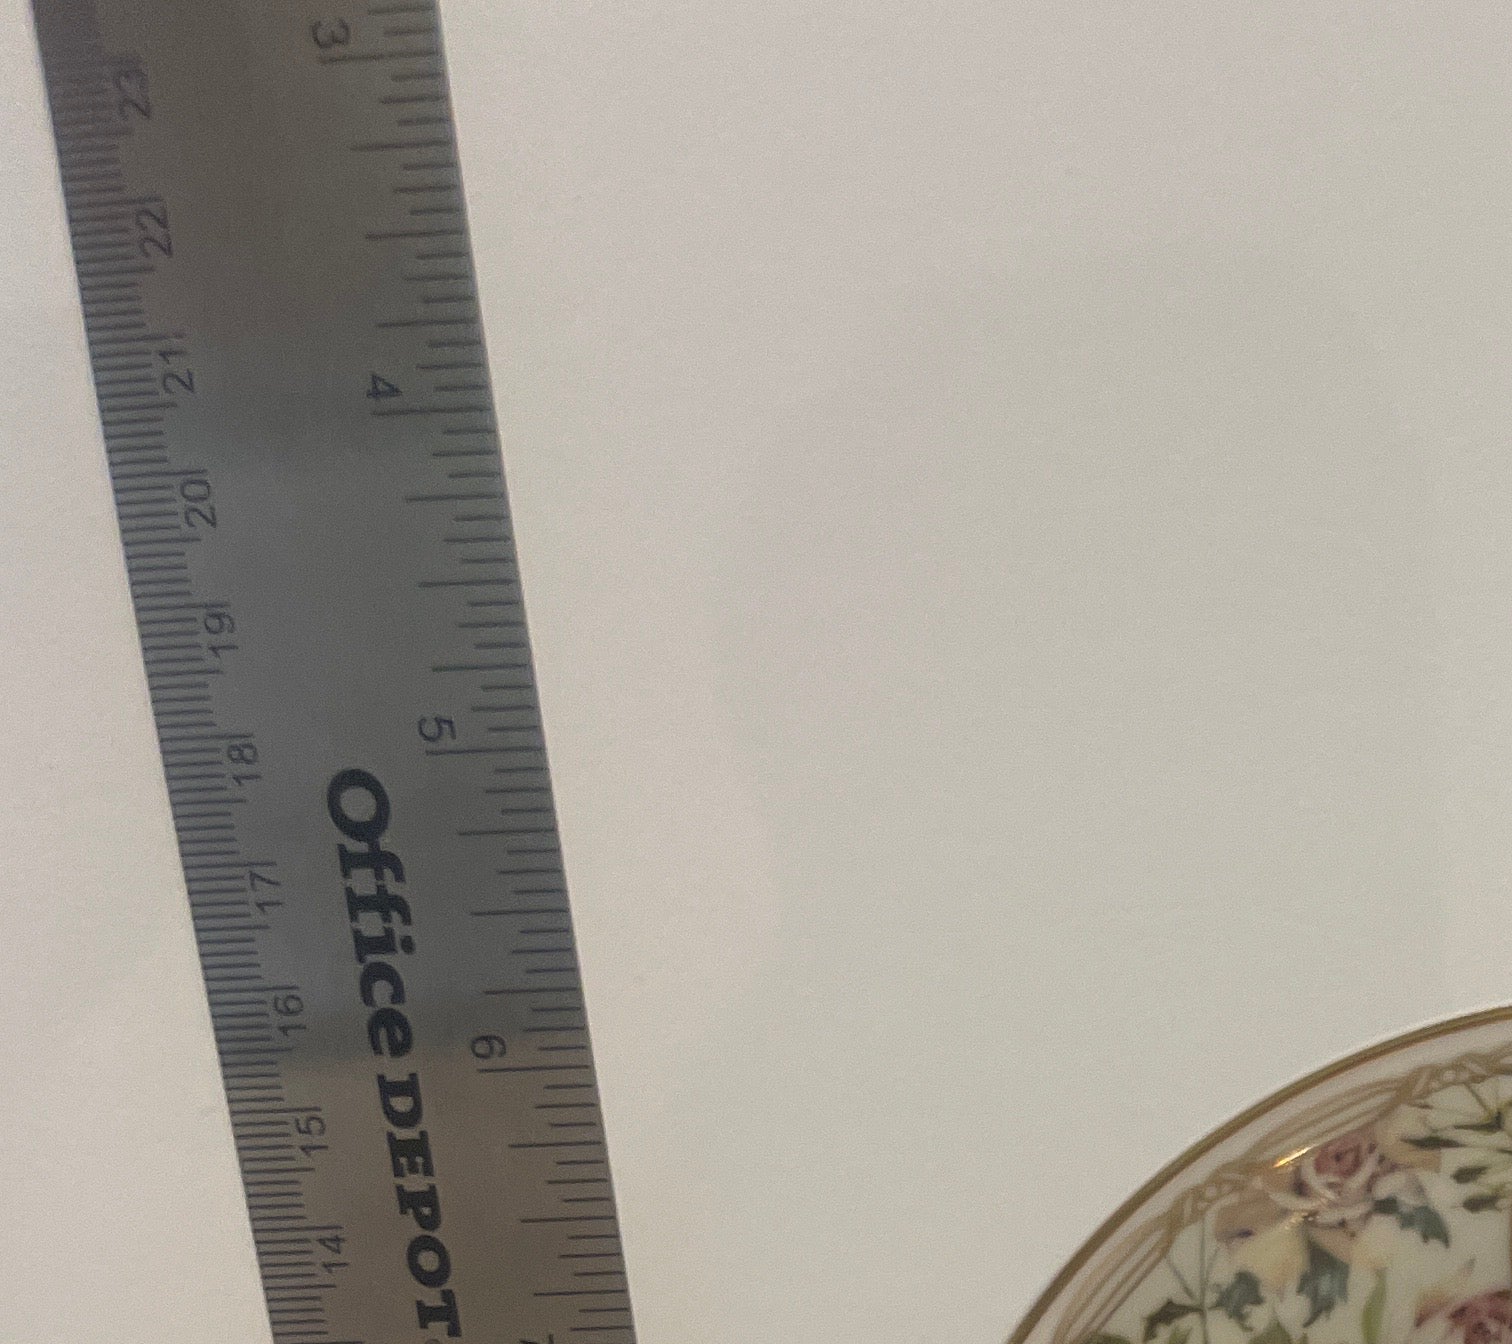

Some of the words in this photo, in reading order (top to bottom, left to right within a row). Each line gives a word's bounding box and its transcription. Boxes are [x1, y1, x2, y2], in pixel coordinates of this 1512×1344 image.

[310, 17, 351, 50] 3
[111, 62, 152, 121] 23
[134, 202, 174, 258] 22
[163, 348, 196, 396] 21
[365, 373, 402, 400] 4
[183, 474, 218, 530] 20
[203, 608, 239, 658] 19
[417, 713, 457, 743] 5
[227, 740, 263, 788] 18
[249, 870, 284, 914] 17
[274, 993, 307, 1037] 16
[326, 768, 416, 1058] Office
[376, 1072, 462, 1338] DEPOT
[470, 1033, 507, 1060] 6
[295, 1113, 329, 1159] 15
[317, 1233, 349, 1274] 14
